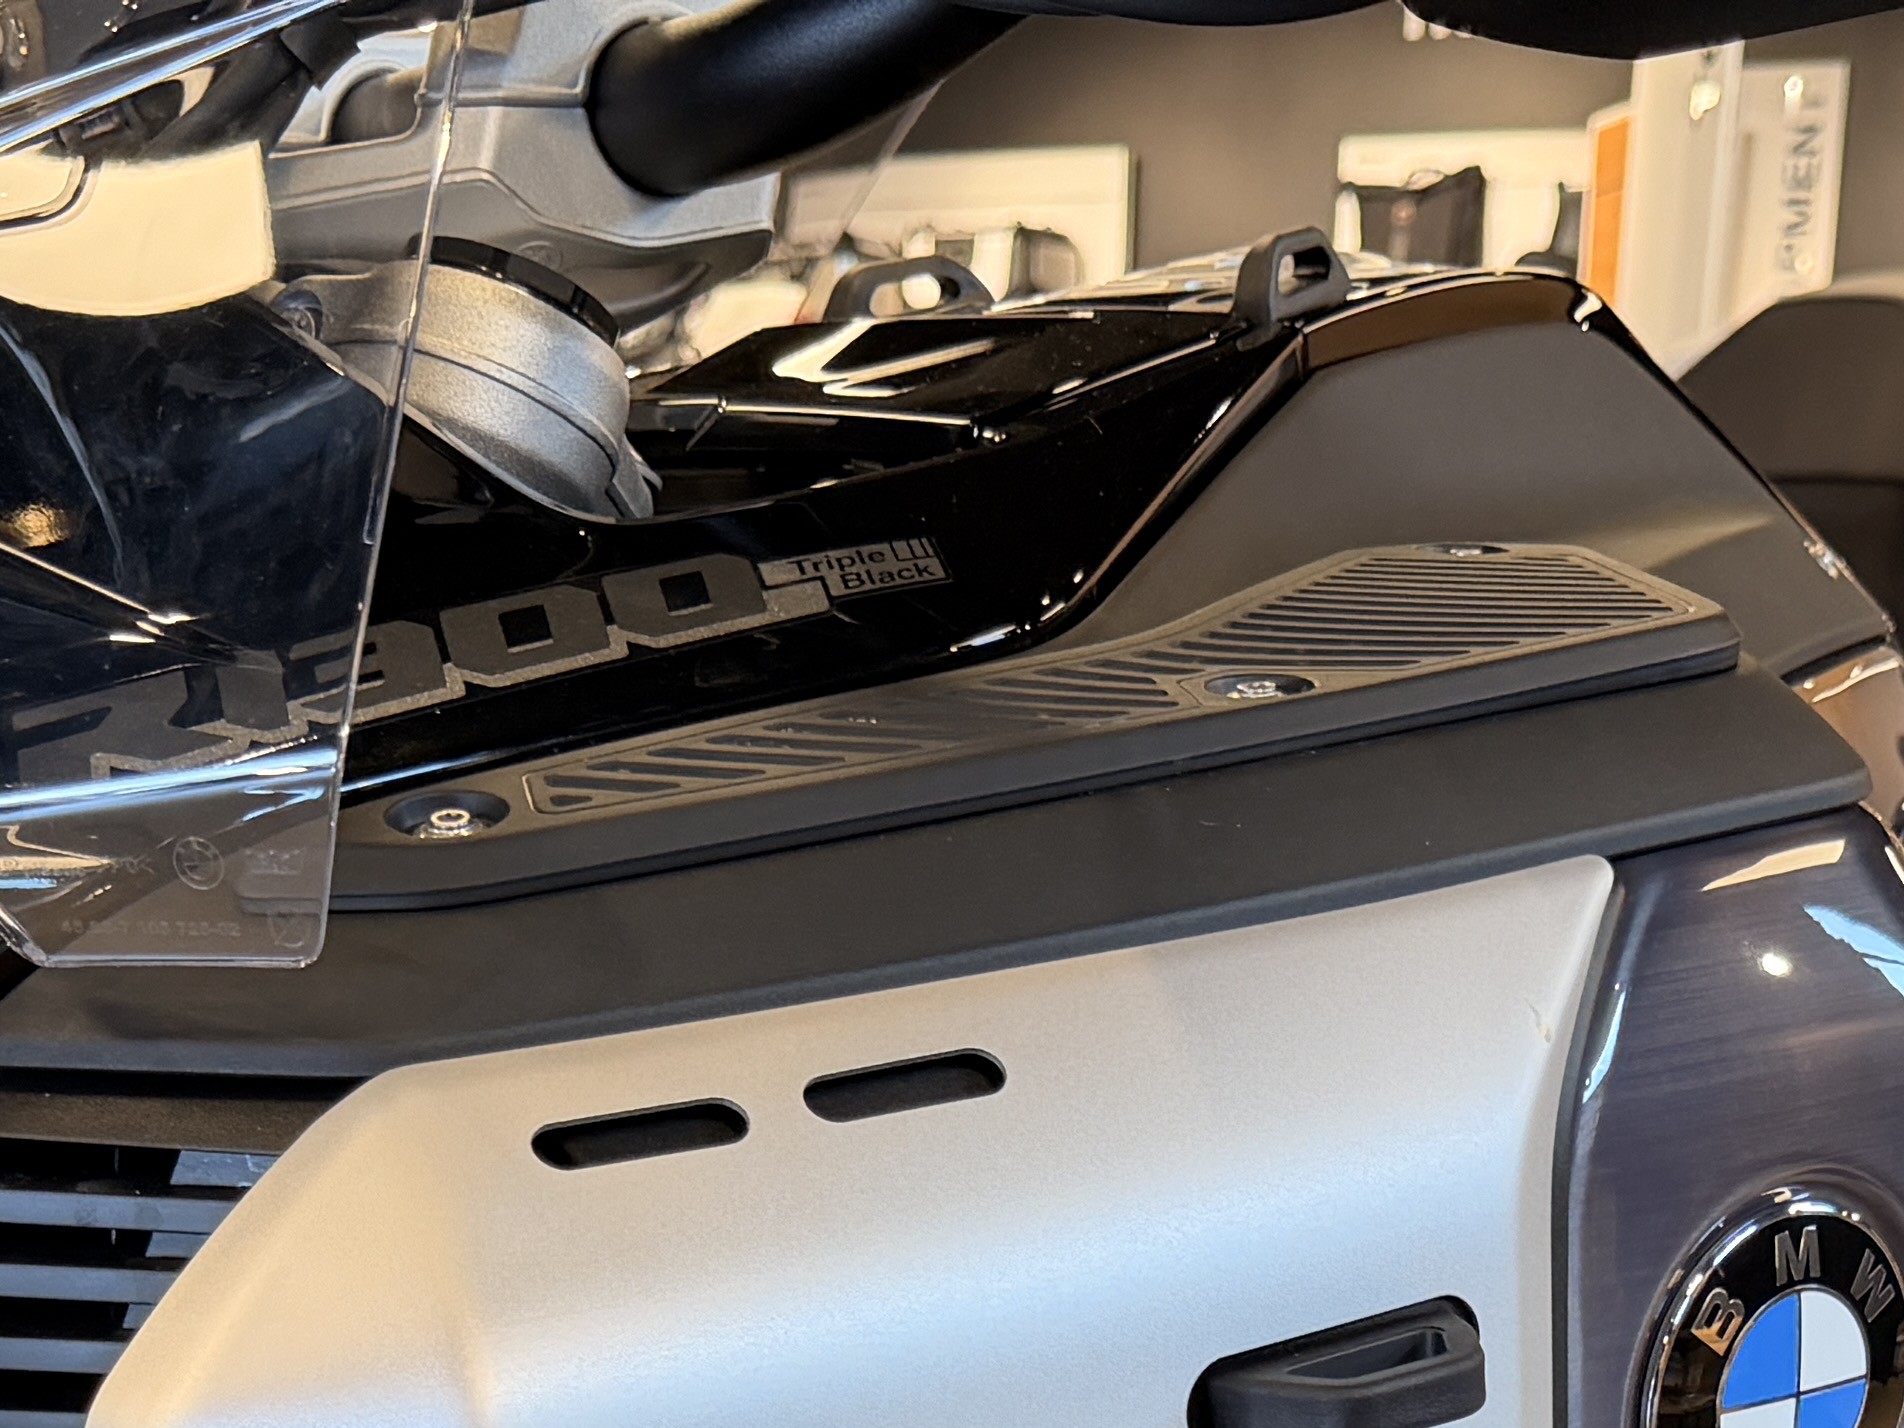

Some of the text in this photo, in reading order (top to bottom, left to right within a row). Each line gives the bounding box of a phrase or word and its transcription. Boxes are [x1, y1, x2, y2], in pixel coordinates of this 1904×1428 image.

[787, 549, 886, 577] Triple
[839, 561, 936, 591] Black
[1690, 1225, 1895, 1356] BMW
